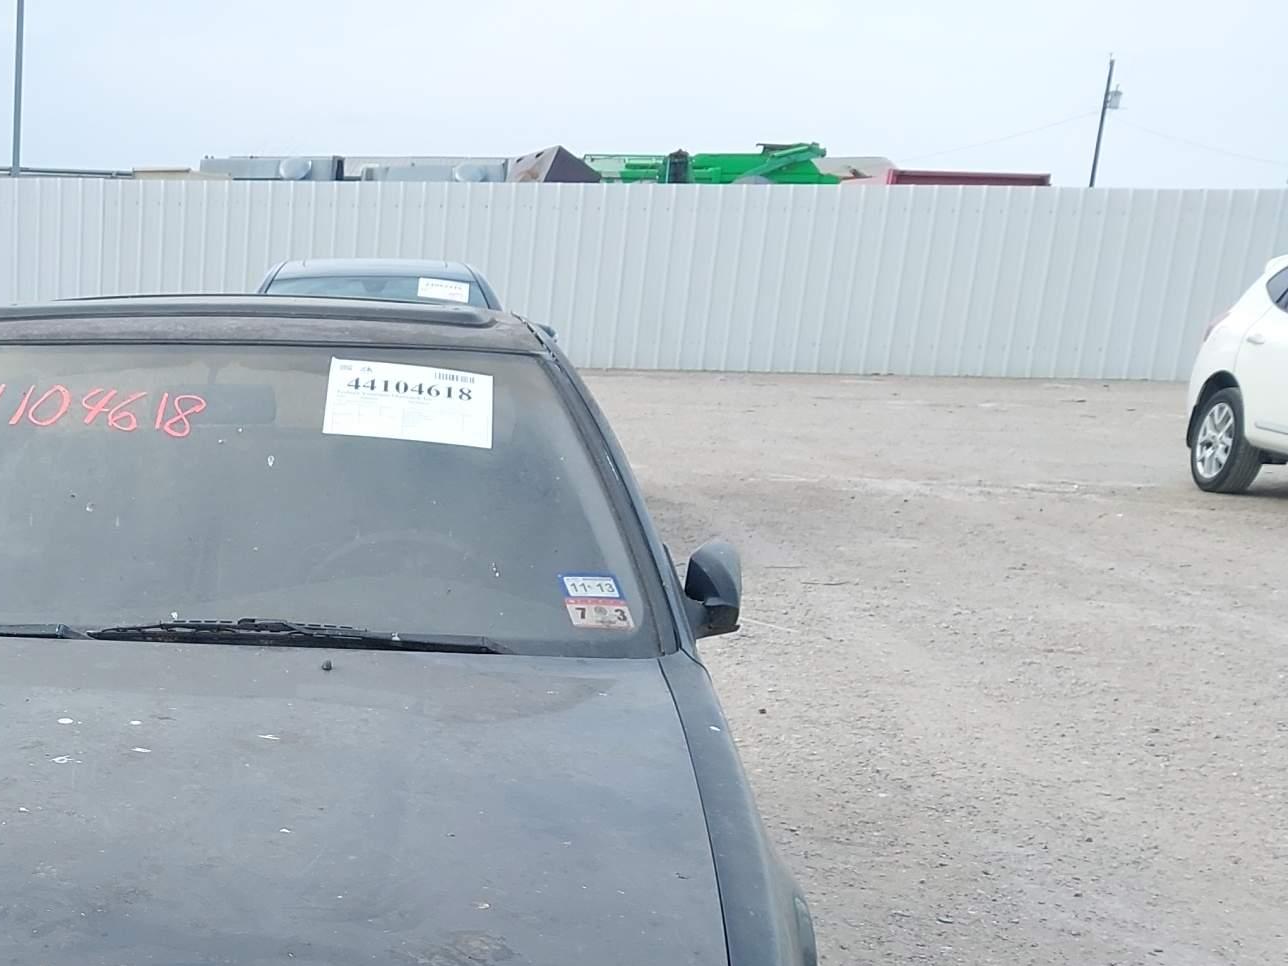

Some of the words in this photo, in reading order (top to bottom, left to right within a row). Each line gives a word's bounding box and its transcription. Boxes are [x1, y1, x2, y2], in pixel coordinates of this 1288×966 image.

[347, 376, 473, 401] 44104618
[575, 607, 586, 619] 7
[614, 608, 627, 622] 3
